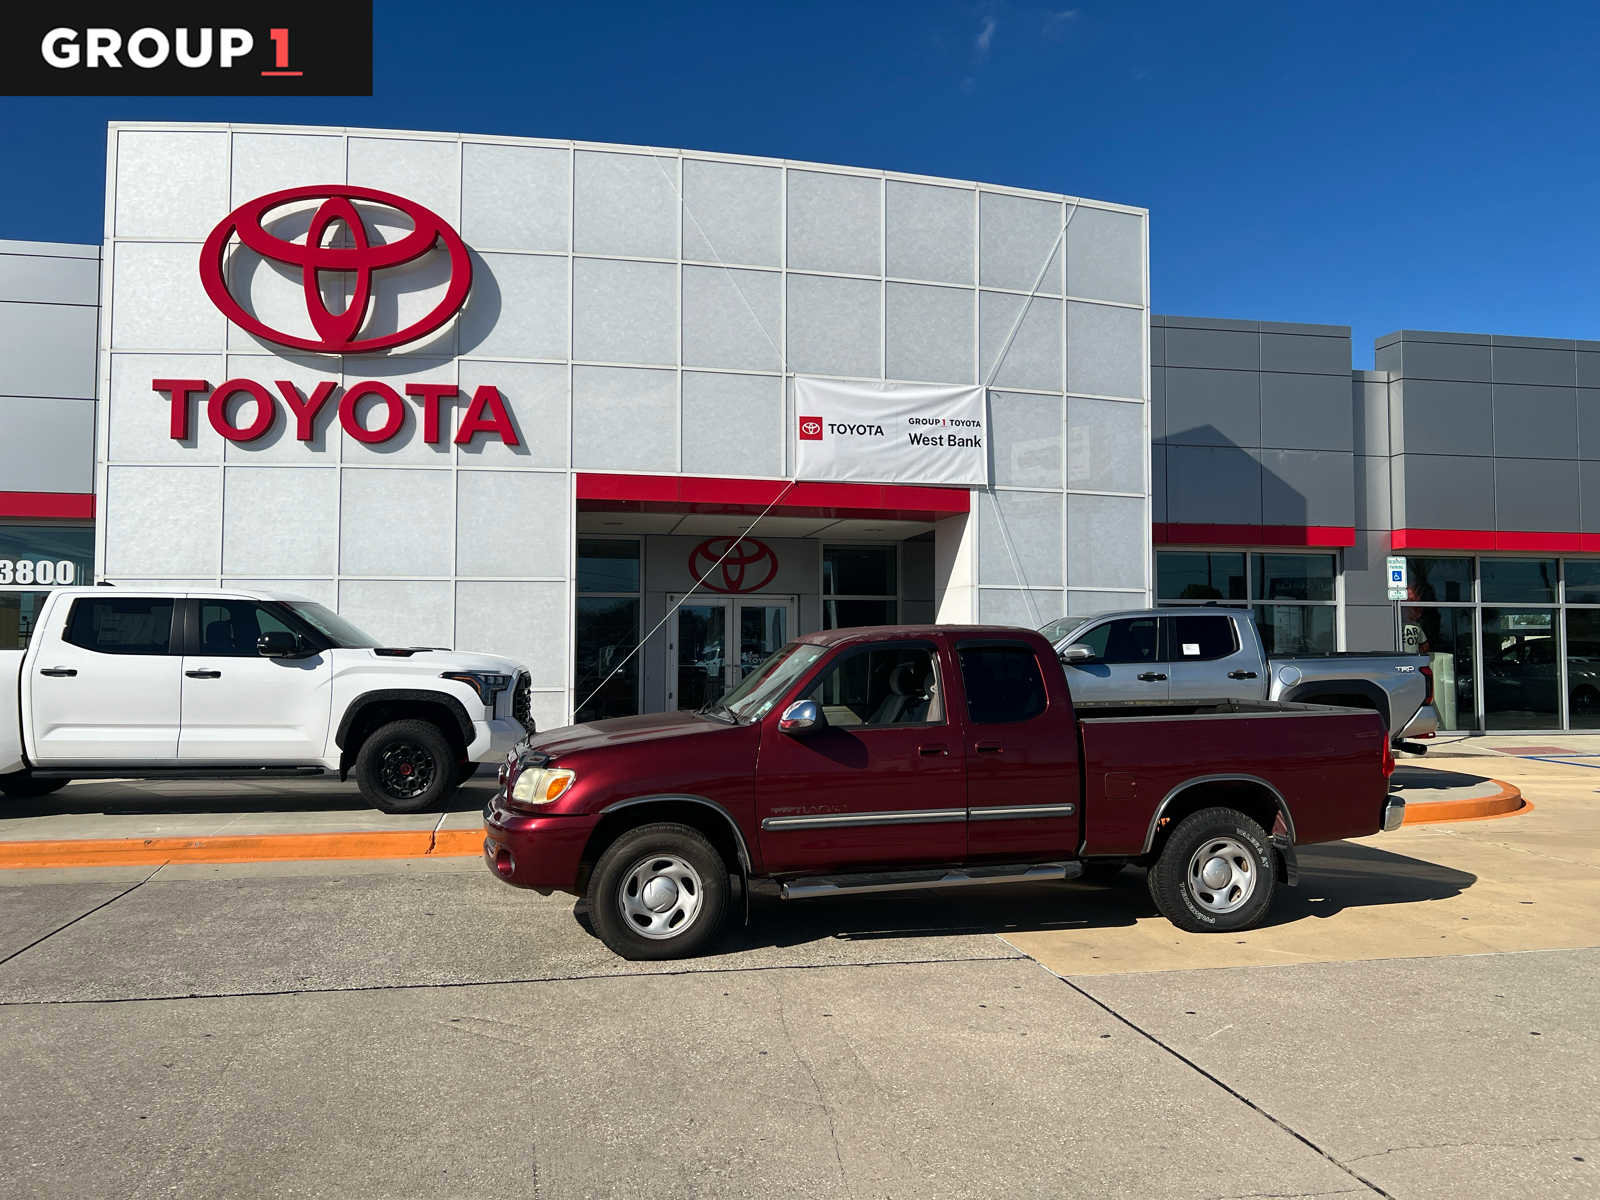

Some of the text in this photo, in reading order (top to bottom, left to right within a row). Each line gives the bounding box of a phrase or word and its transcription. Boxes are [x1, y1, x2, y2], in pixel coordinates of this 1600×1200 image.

[152, 378, 520, 446] TOYOTA
[908, 417, 981, 428] GROUP 1 TOYOTA
[828, 423, 884, 436] TOYOTA
[908, 432, 982, 448] West Bank
[0, 560, 74, 585] 3800
[1403, 627, 1418, 637] AR
[1394, 665, 1415, 673] TRD
